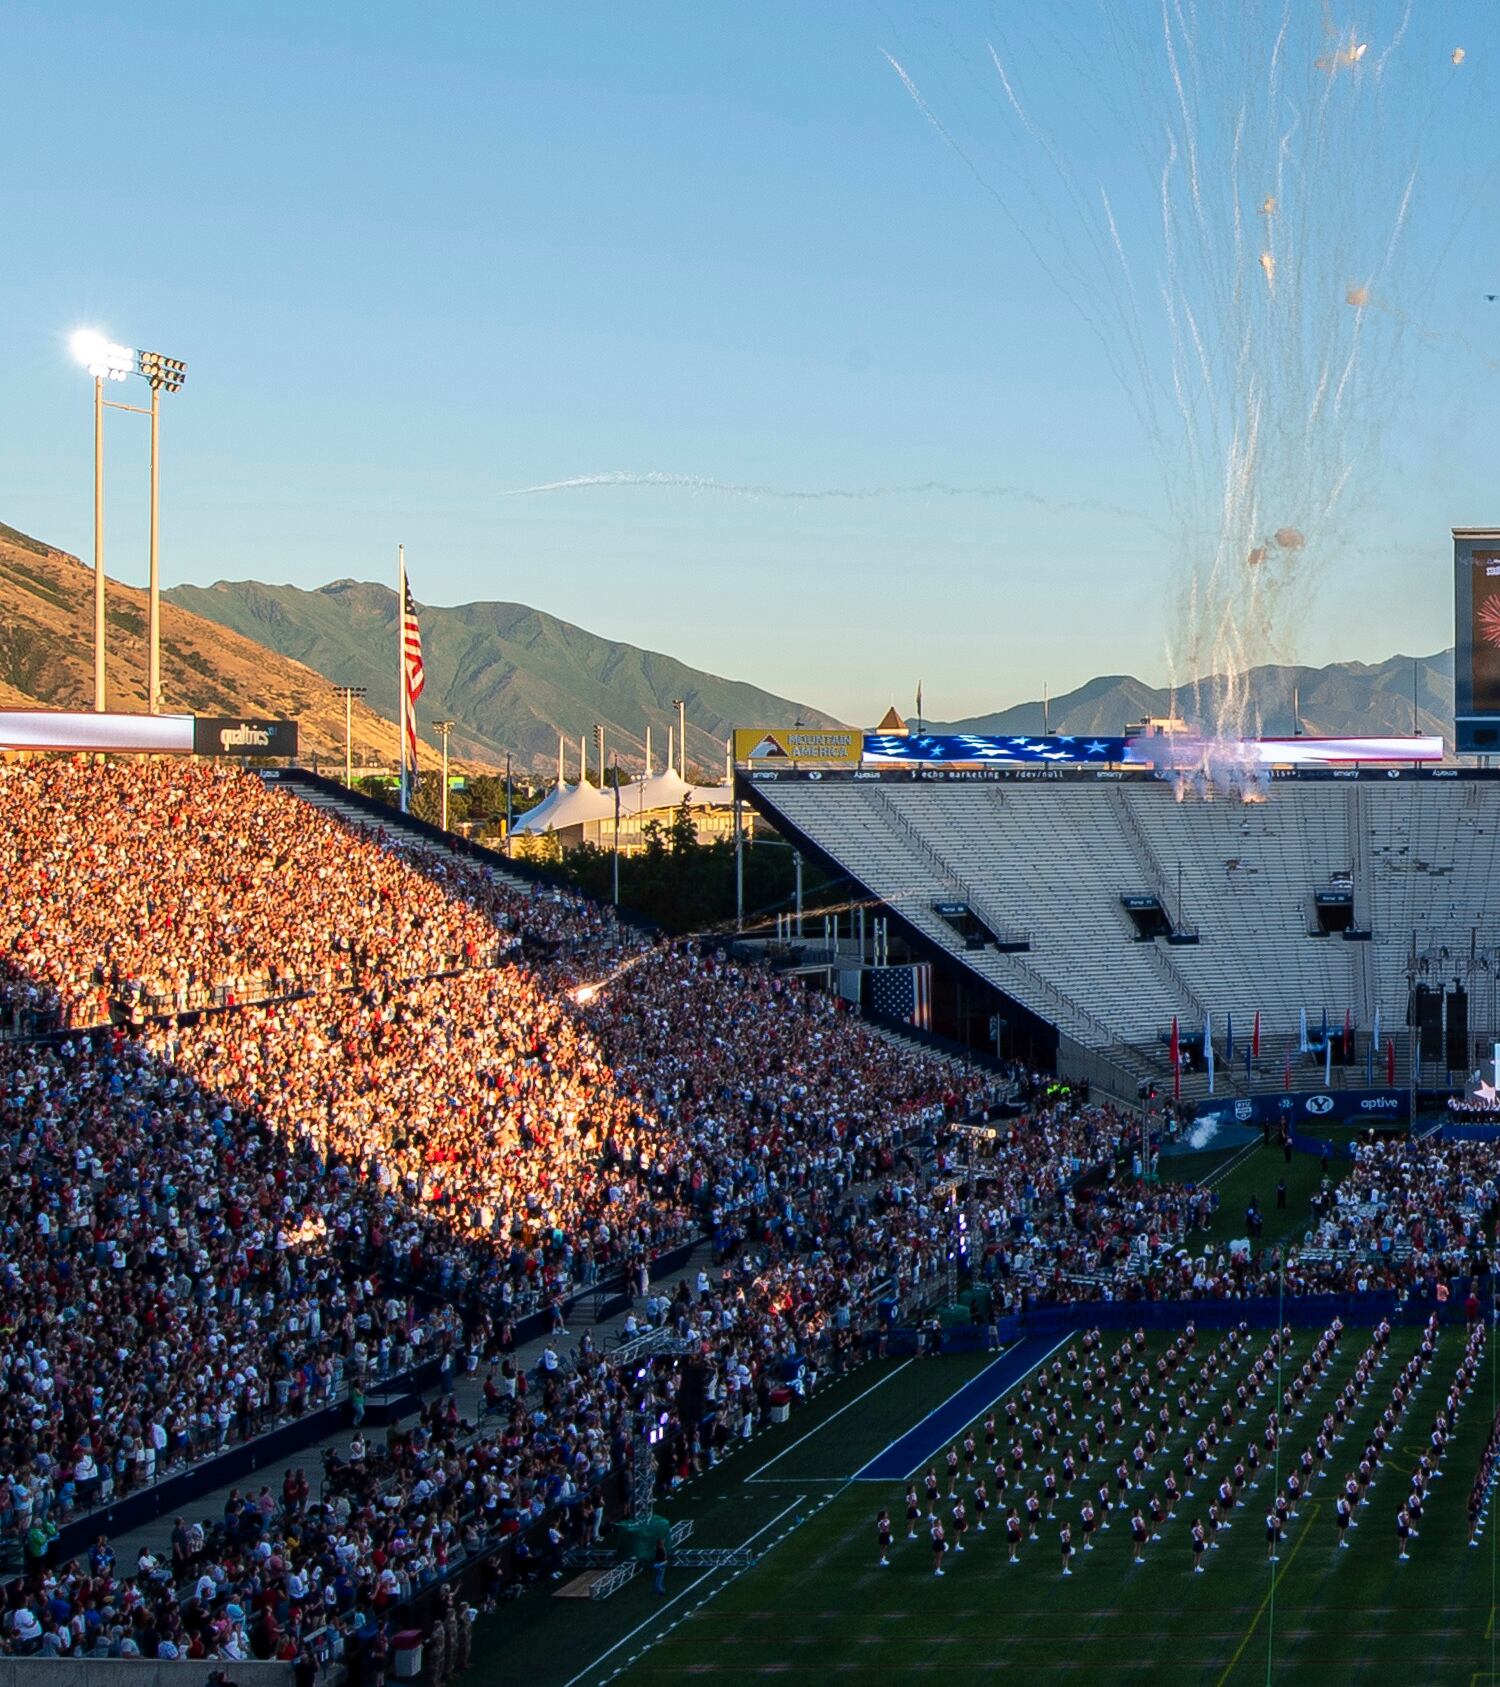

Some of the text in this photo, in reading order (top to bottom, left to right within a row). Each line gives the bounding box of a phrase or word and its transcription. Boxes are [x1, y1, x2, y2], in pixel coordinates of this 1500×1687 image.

[788, 734, 852, 745] MOUNTAIN
[792, 746, 848, 757] AMERICA
[922, 770, 944, 779] echo
[949, 770, 999, 779] marketing
[1016, 770, 1063, 779] /dev/null
[1360, 1096, 1398, 1111] aptive
